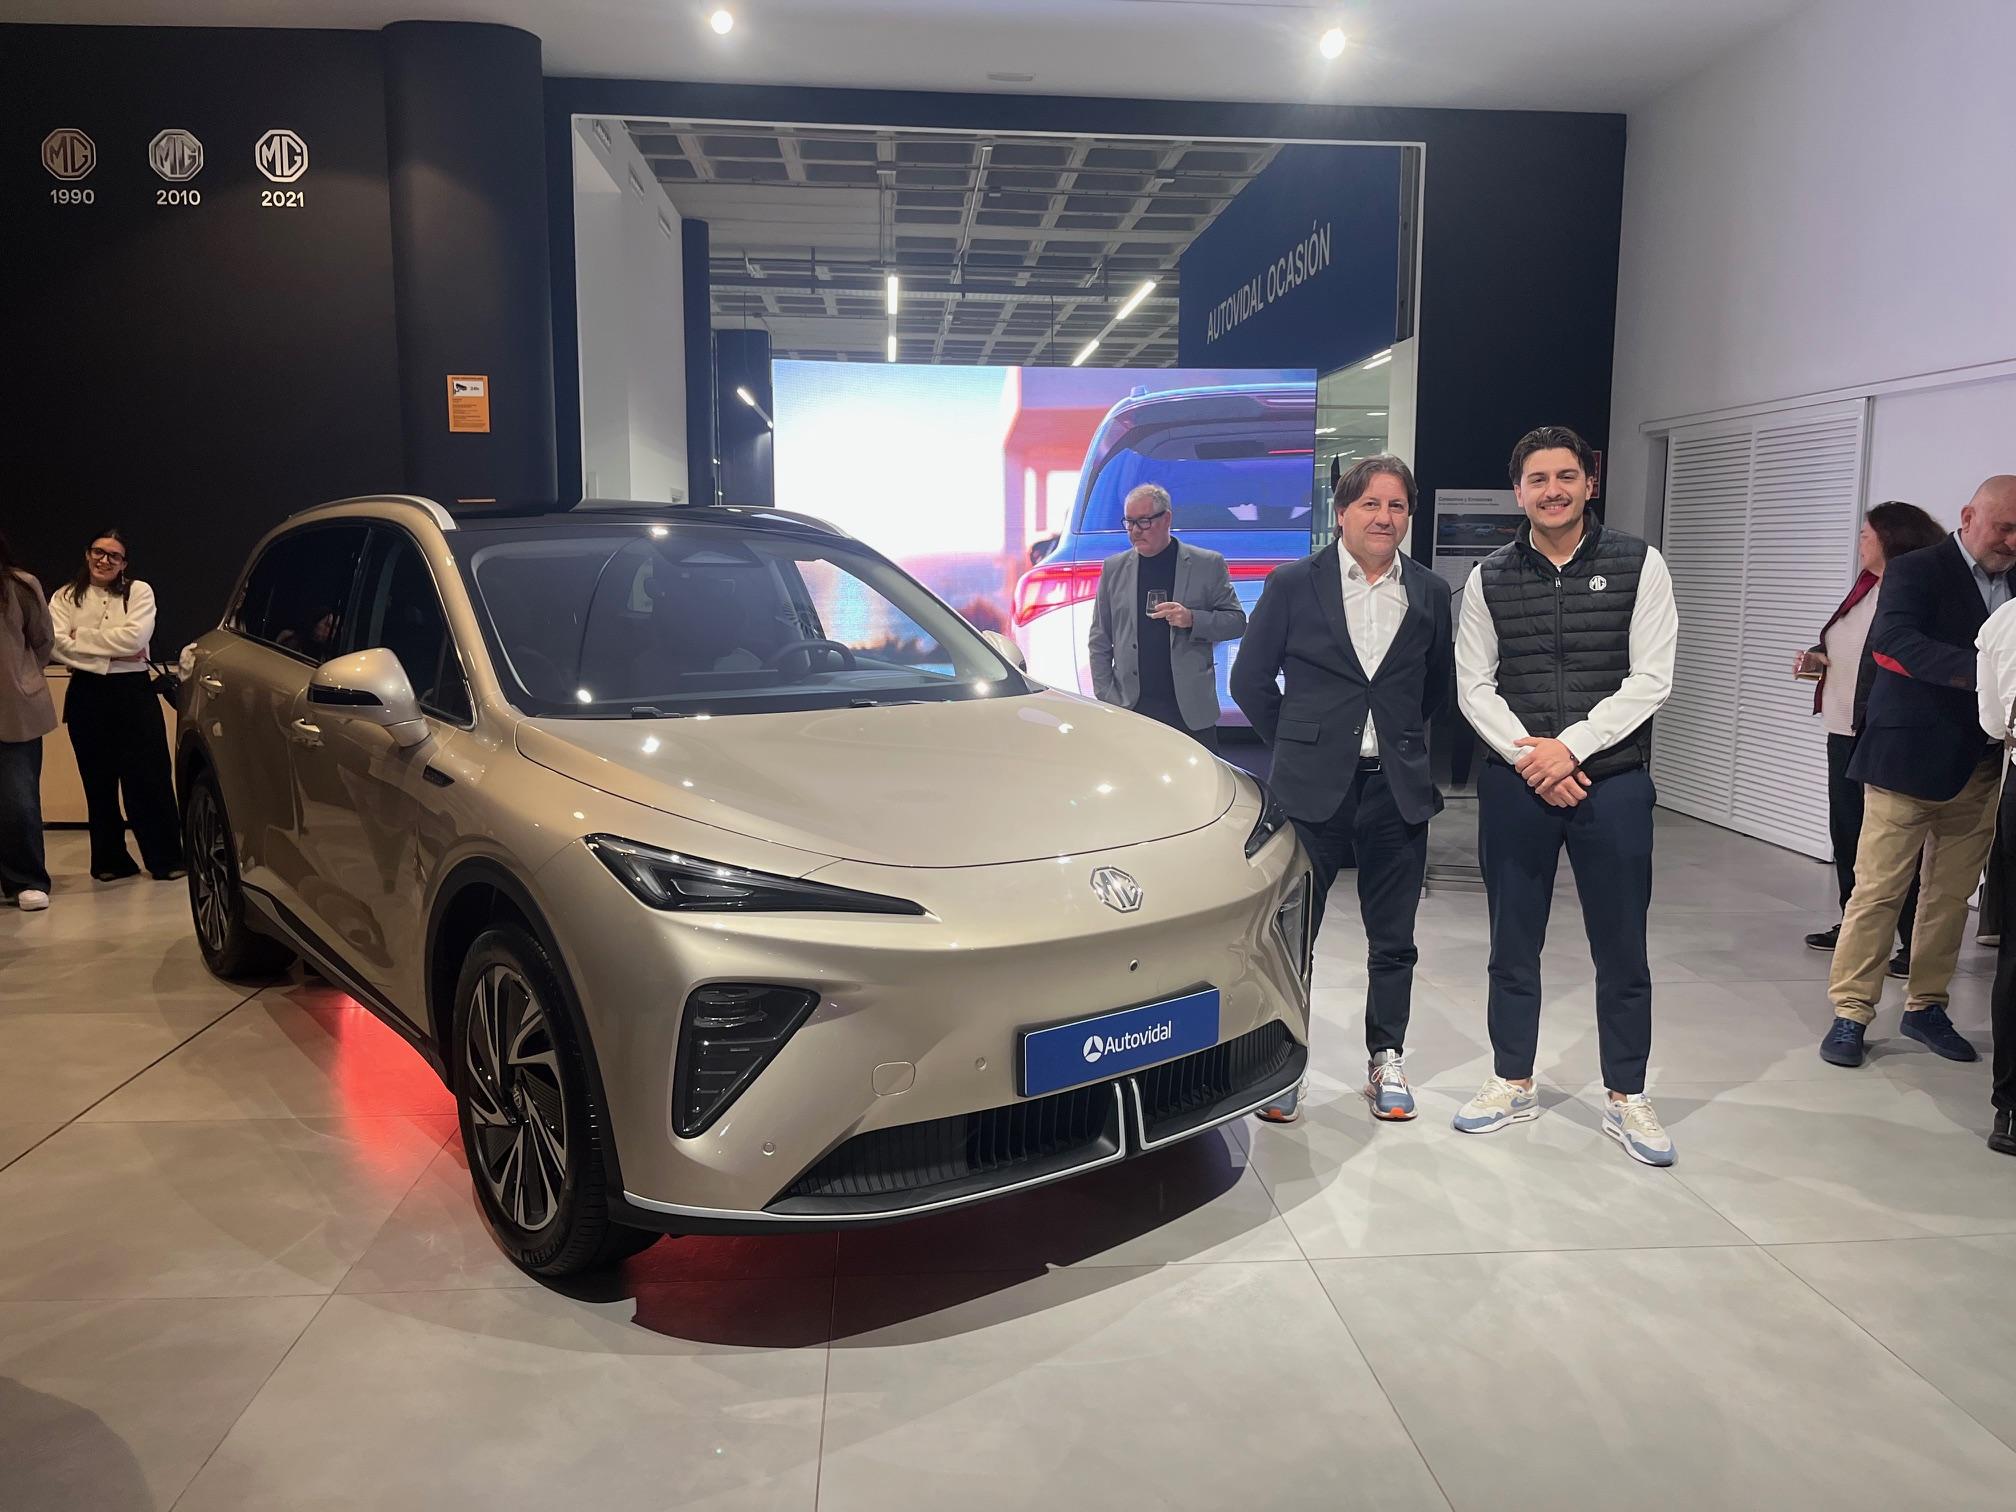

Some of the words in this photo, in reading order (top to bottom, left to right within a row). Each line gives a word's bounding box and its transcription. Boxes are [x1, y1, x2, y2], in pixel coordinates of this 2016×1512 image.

[45, 132, 93, 177] MG
[152, 132, 200, 178] MG
[257, 132, 304, 179] MG
[50, 189, 95, 205] 1990
[156, 189, 201, 206] 2010
[261, 190, 305, 208] 2021
[1206, 273, 1264, 345] AUTOVIDAL
[1266, 218, 1331, 304] OCASIÓN
[1093, 868, 1141, 911] MG
[1103, 1020, 1172, 1056] Autovidal
